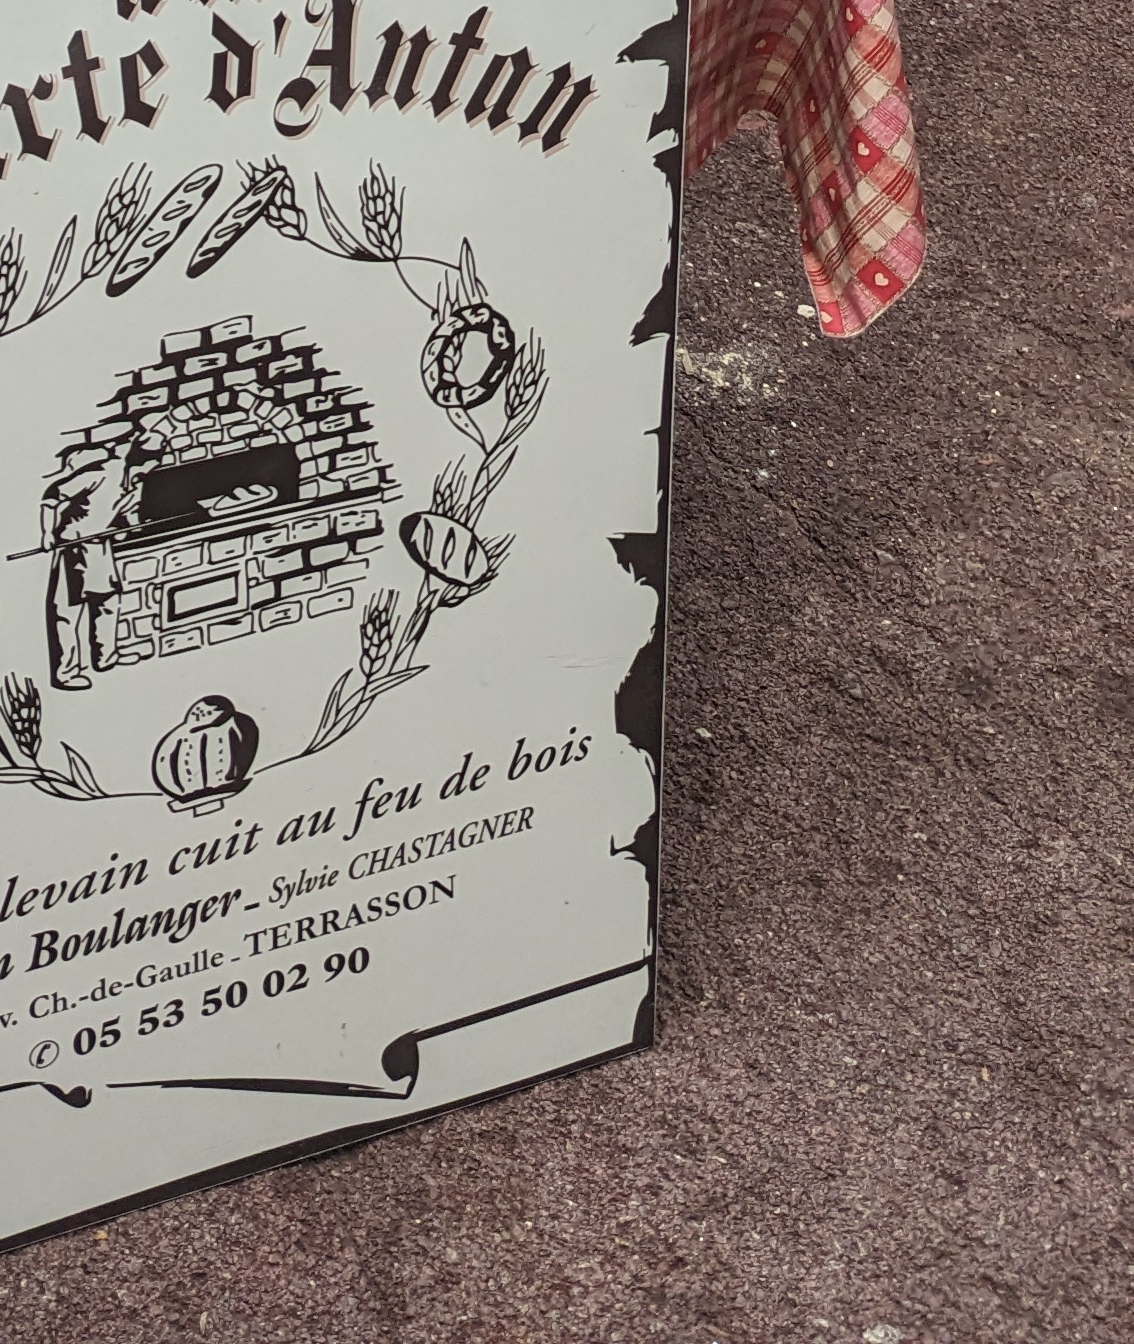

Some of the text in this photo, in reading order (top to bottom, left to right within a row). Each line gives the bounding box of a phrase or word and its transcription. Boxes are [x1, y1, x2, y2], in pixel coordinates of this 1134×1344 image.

[168, 818, 263, 876] cuit
[276, 806, 336, 846] au
[342, 777, 422, 842] feu
[439, 751, 491, 800] de
[507, 726, 592, 781] bois
[268, 864, 340, 910] Sylvie
[348, 806, 534, 880] CHASTAGNER
[29, 949, 224, 1019] Ch.-de-Gaulle
[243, 874, 457, 957] TERRASSON
[73, 946, 370, 1056] 05 53 50 02 90
